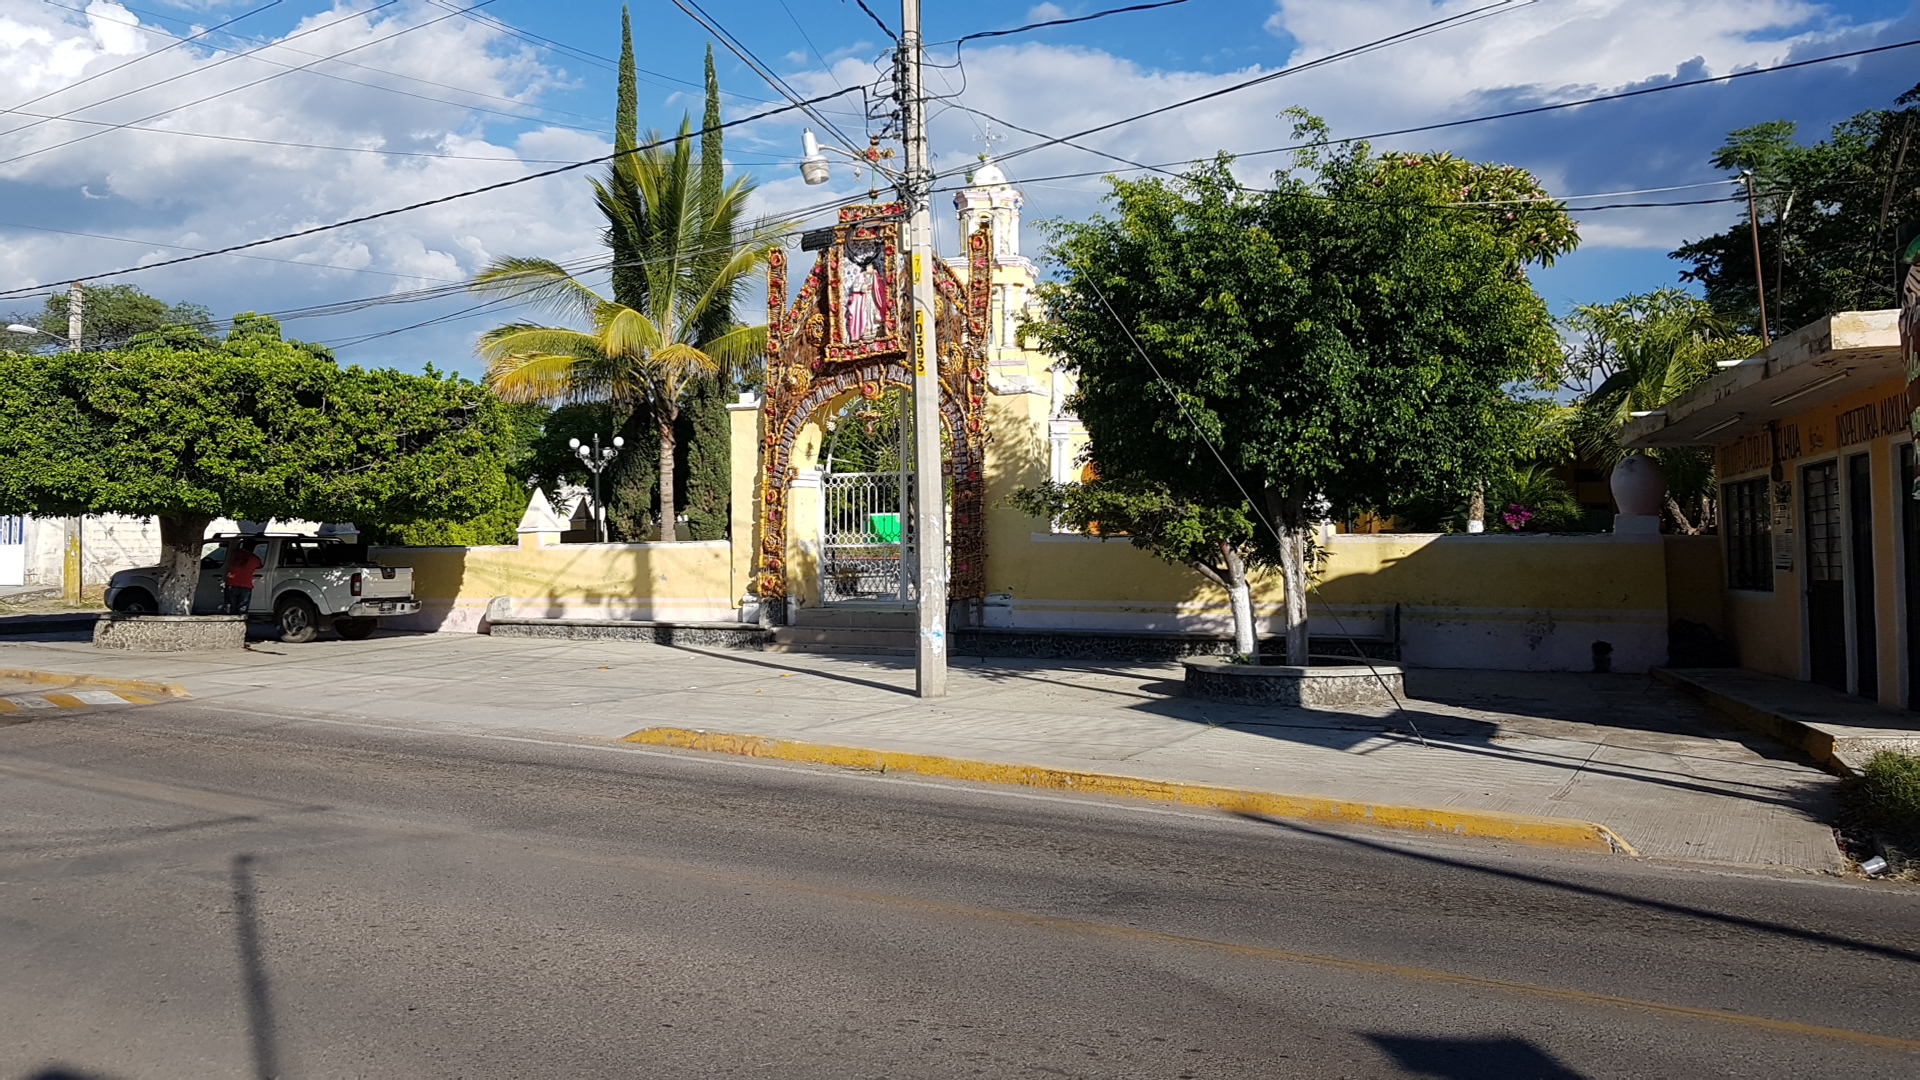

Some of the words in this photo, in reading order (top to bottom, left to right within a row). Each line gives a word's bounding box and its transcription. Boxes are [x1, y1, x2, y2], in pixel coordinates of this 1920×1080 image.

[915, 310, 925, 372] F0393
[1772, 423, 1802, 463] ELHUA
[1836, 402, 1880, 449] INSPECTORIA
[1880, 391, 1911, 437] AUXILIA
